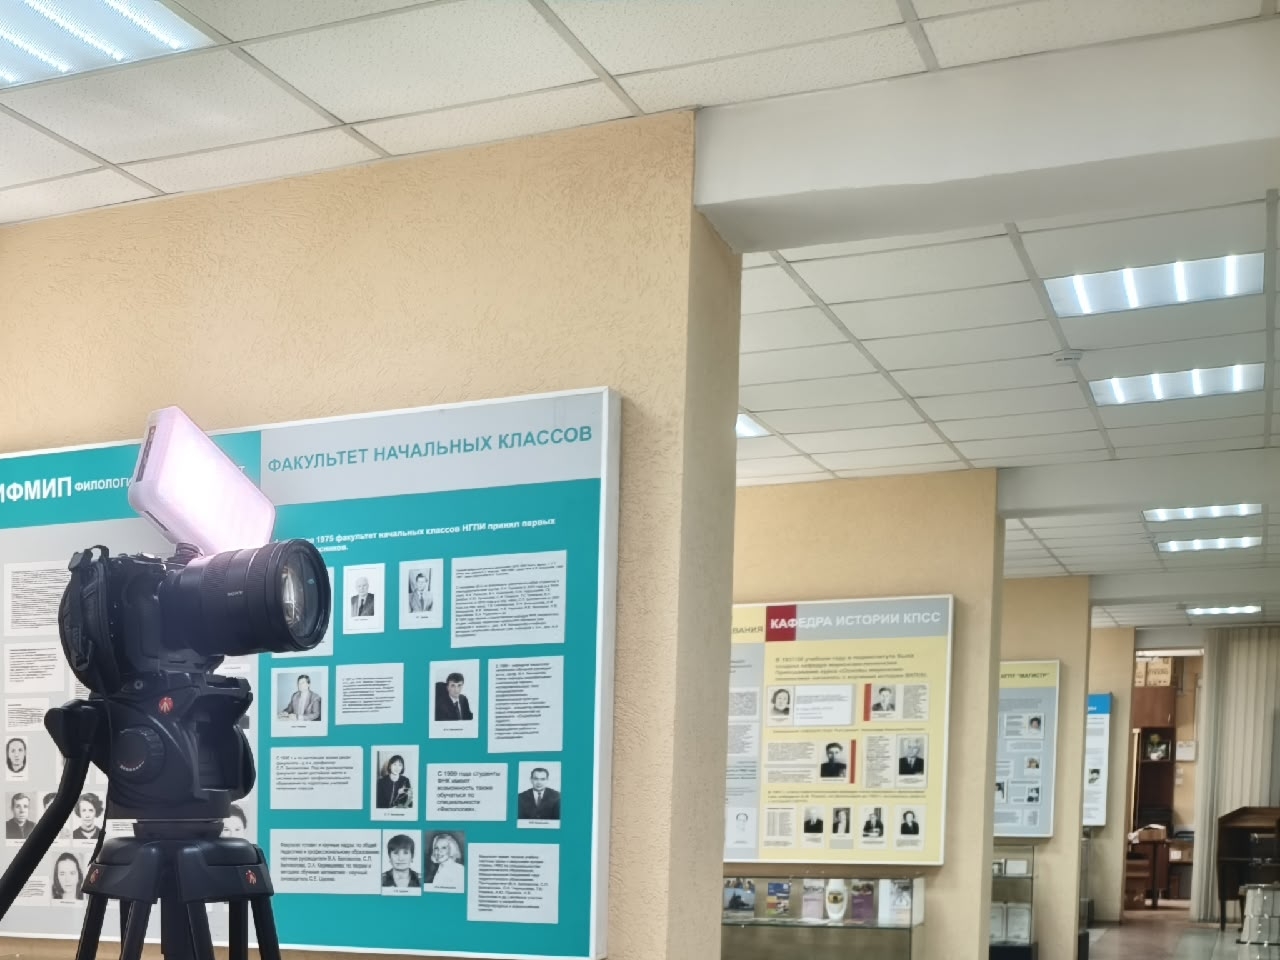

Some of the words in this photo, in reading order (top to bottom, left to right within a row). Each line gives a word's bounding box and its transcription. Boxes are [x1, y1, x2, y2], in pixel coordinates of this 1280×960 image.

[268, 448, 369, 472] ФАКУЛЬТЕТ
[374, 436, 492, 461] НАЧАЛЬНЫХ
[498, 425, 593, 449] КЛАССОВ
[74, 478, 132, 492] ФИЛОЛОГИ
[426, 526, 460, 535] классов
[770, 616, 833, 629] КАФЕДРА
[836, 614, 900, 626] ИСТОРИИ
[903, 612, 942, 624] КПСС
[732, 626, 763, 634] ВАНИЯ
